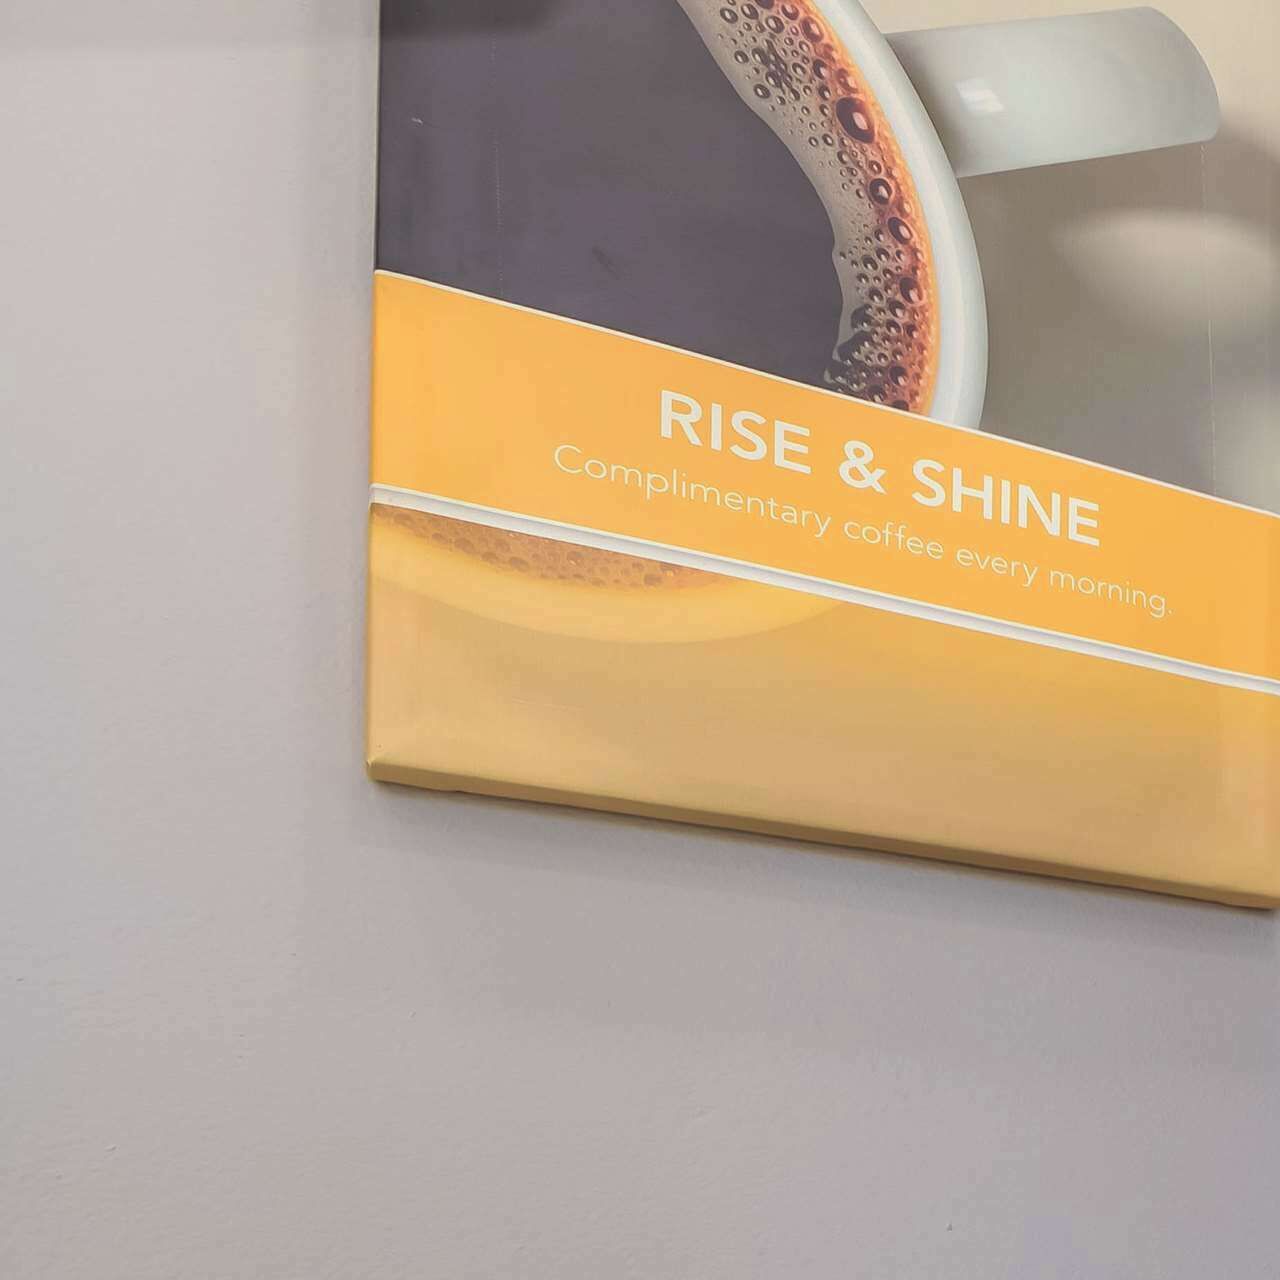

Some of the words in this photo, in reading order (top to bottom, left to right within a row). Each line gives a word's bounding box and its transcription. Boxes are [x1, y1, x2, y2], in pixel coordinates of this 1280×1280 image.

[554, 444, 832, 538] Complimentary
[843, 520, 944, 560] coffee
[956, 548, 1038, 588] every
[1049, 568, 1173, 618] morning.
[660, 390, 812, 474] RISE
[838, 440, 888, 494] &
[911, 459, 1100, 547] SHINE
